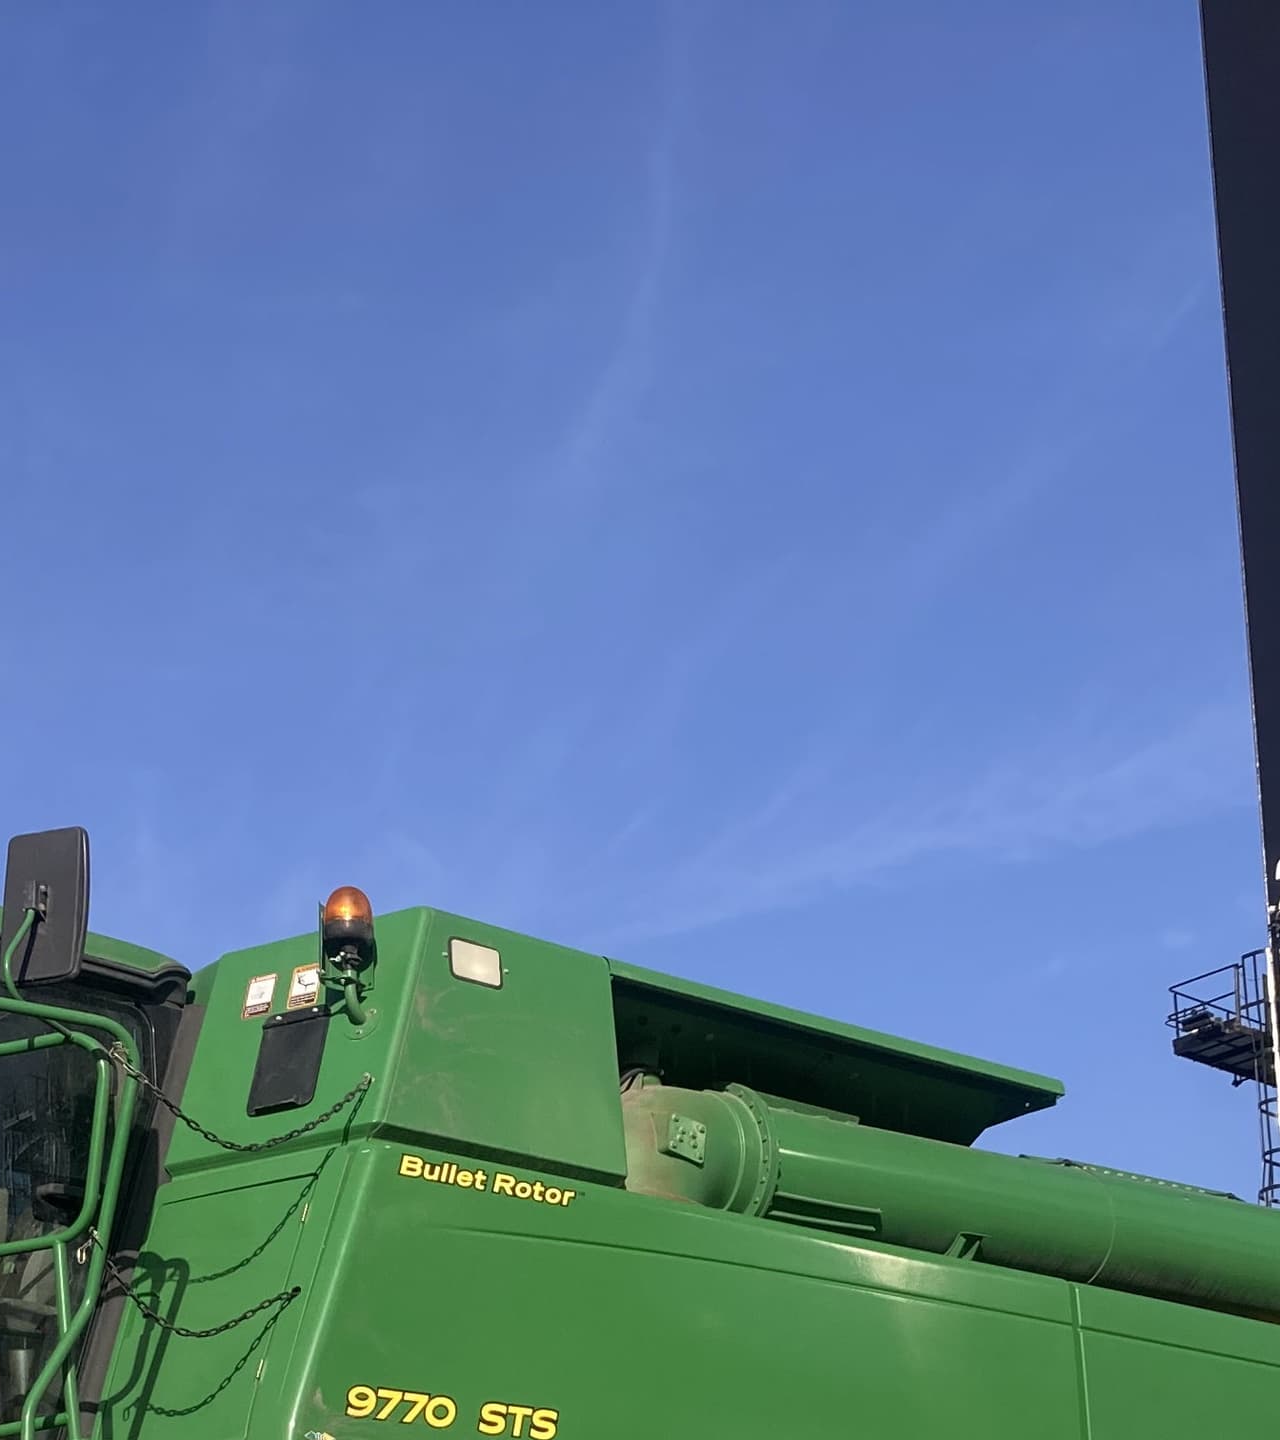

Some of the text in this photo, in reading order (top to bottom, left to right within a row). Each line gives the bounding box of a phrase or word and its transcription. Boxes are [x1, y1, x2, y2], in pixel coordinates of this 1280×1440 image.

[399, 1153, 576, 1207] Bullet Rotor
[345, 1384, 458, 1430] 9770
